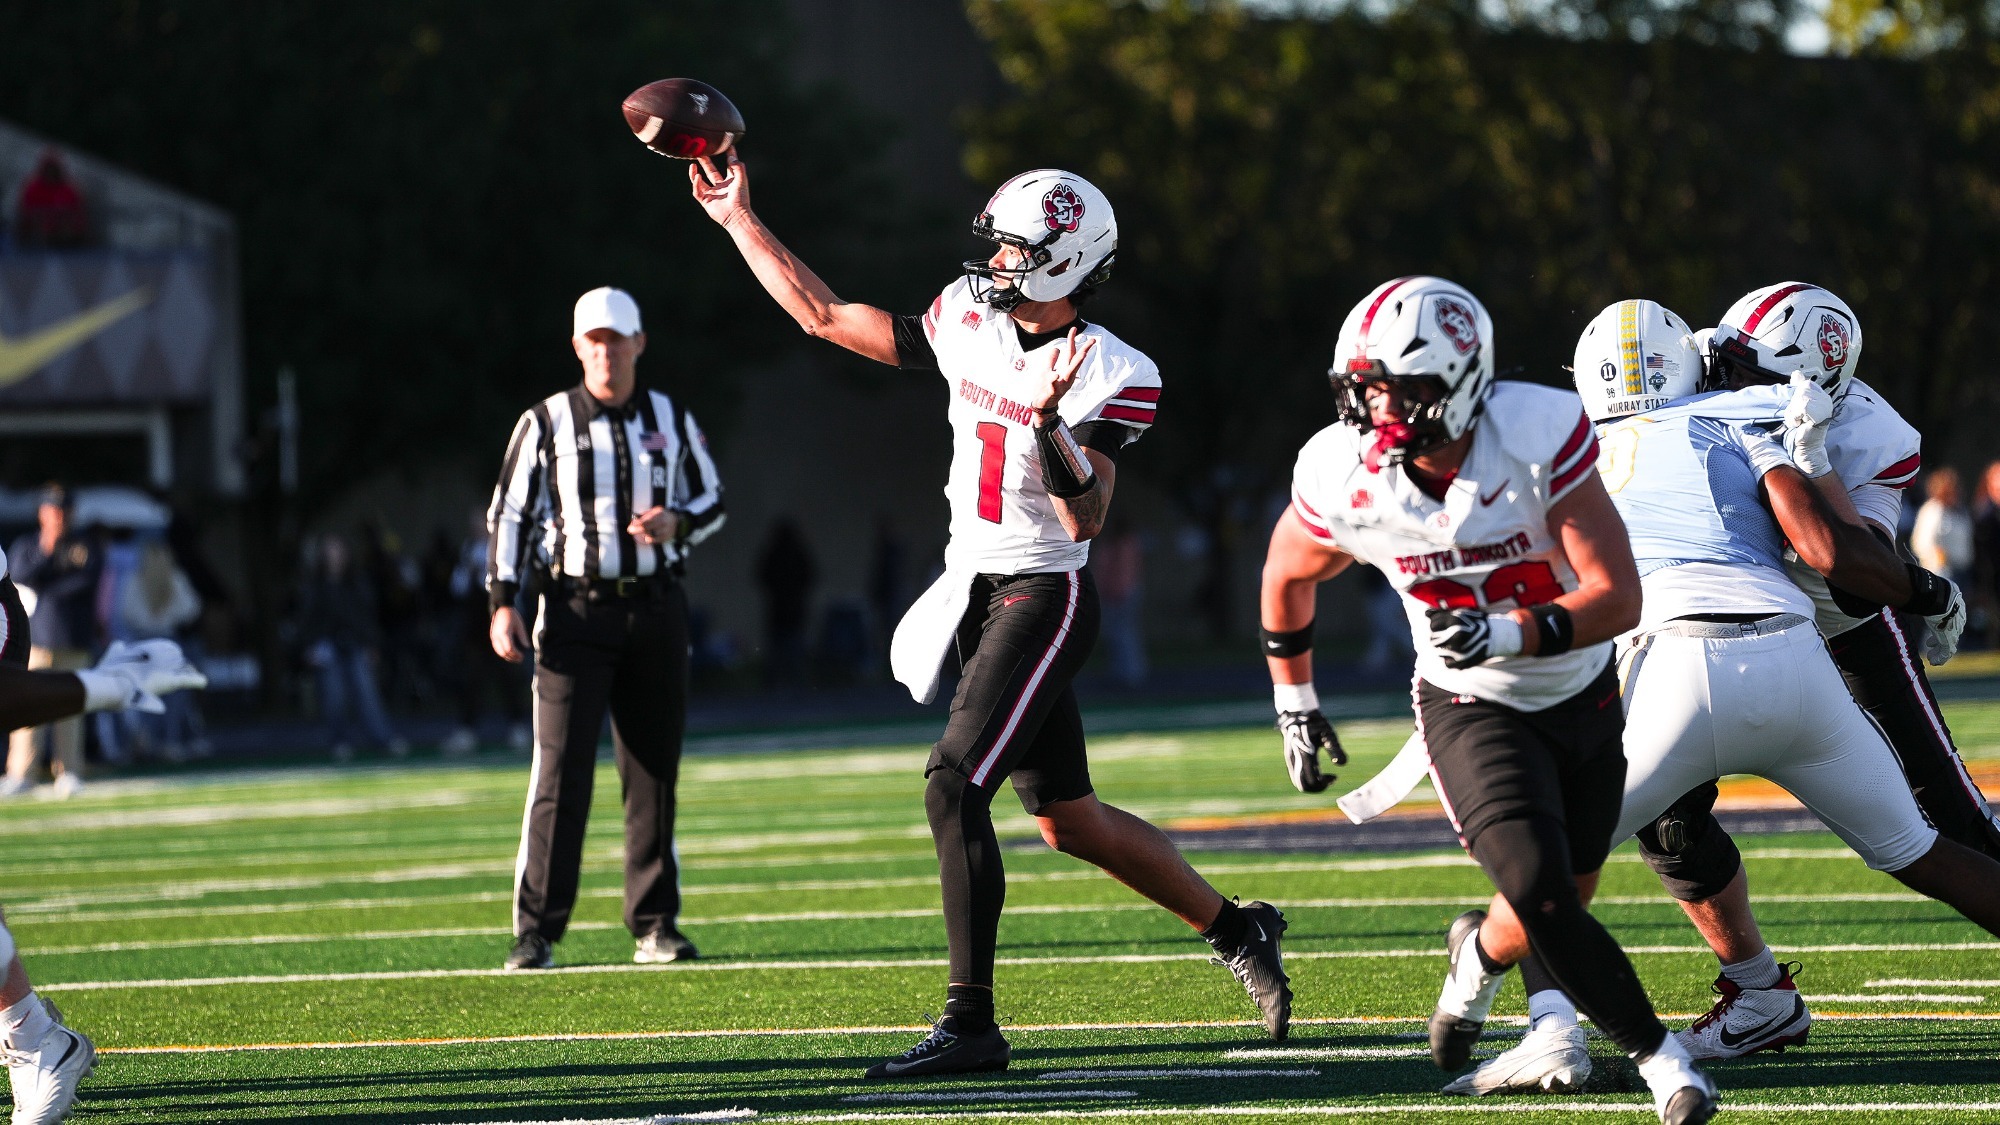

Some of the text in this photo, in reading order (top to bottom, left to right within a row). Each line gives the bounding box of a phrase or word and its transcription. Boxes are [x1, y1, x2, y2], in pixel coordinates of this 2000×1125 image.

[959, 378, 1033, 427] SOUTH DAKO
[1607, 400, 1641, 414] MURRAY
[976, 421, 1008, 524] 1
[1395, 532, 1531, 575] SOUTH DAKOTA
